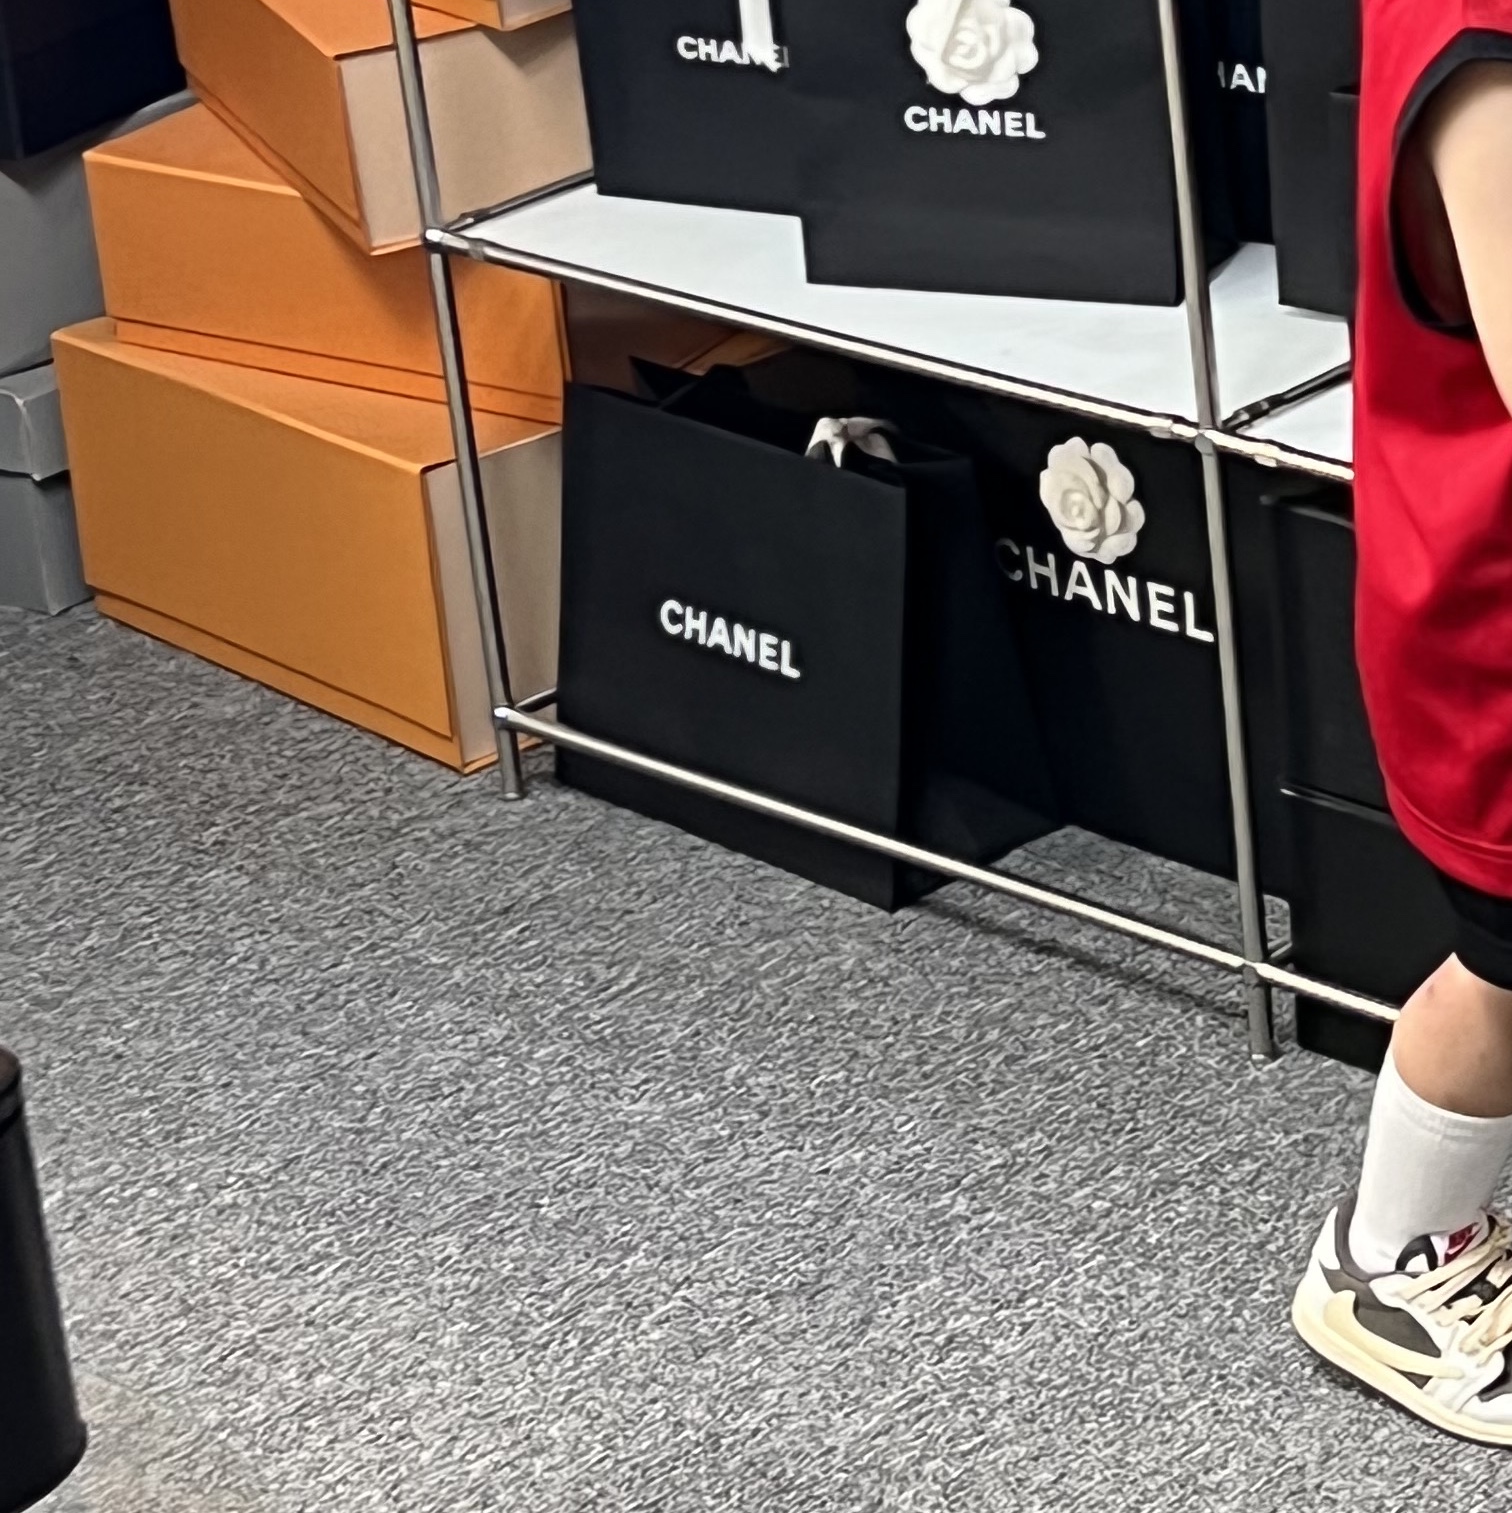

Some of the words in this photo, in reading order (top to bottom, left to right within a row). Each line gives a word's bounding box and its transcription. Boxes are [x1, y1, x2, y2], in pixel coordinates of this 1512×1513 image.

[903, 104, 1046, 140] CHANEL
[995, 536, 1215, 644] CHANEL
[660, 598, 801, 681] CHANEL
